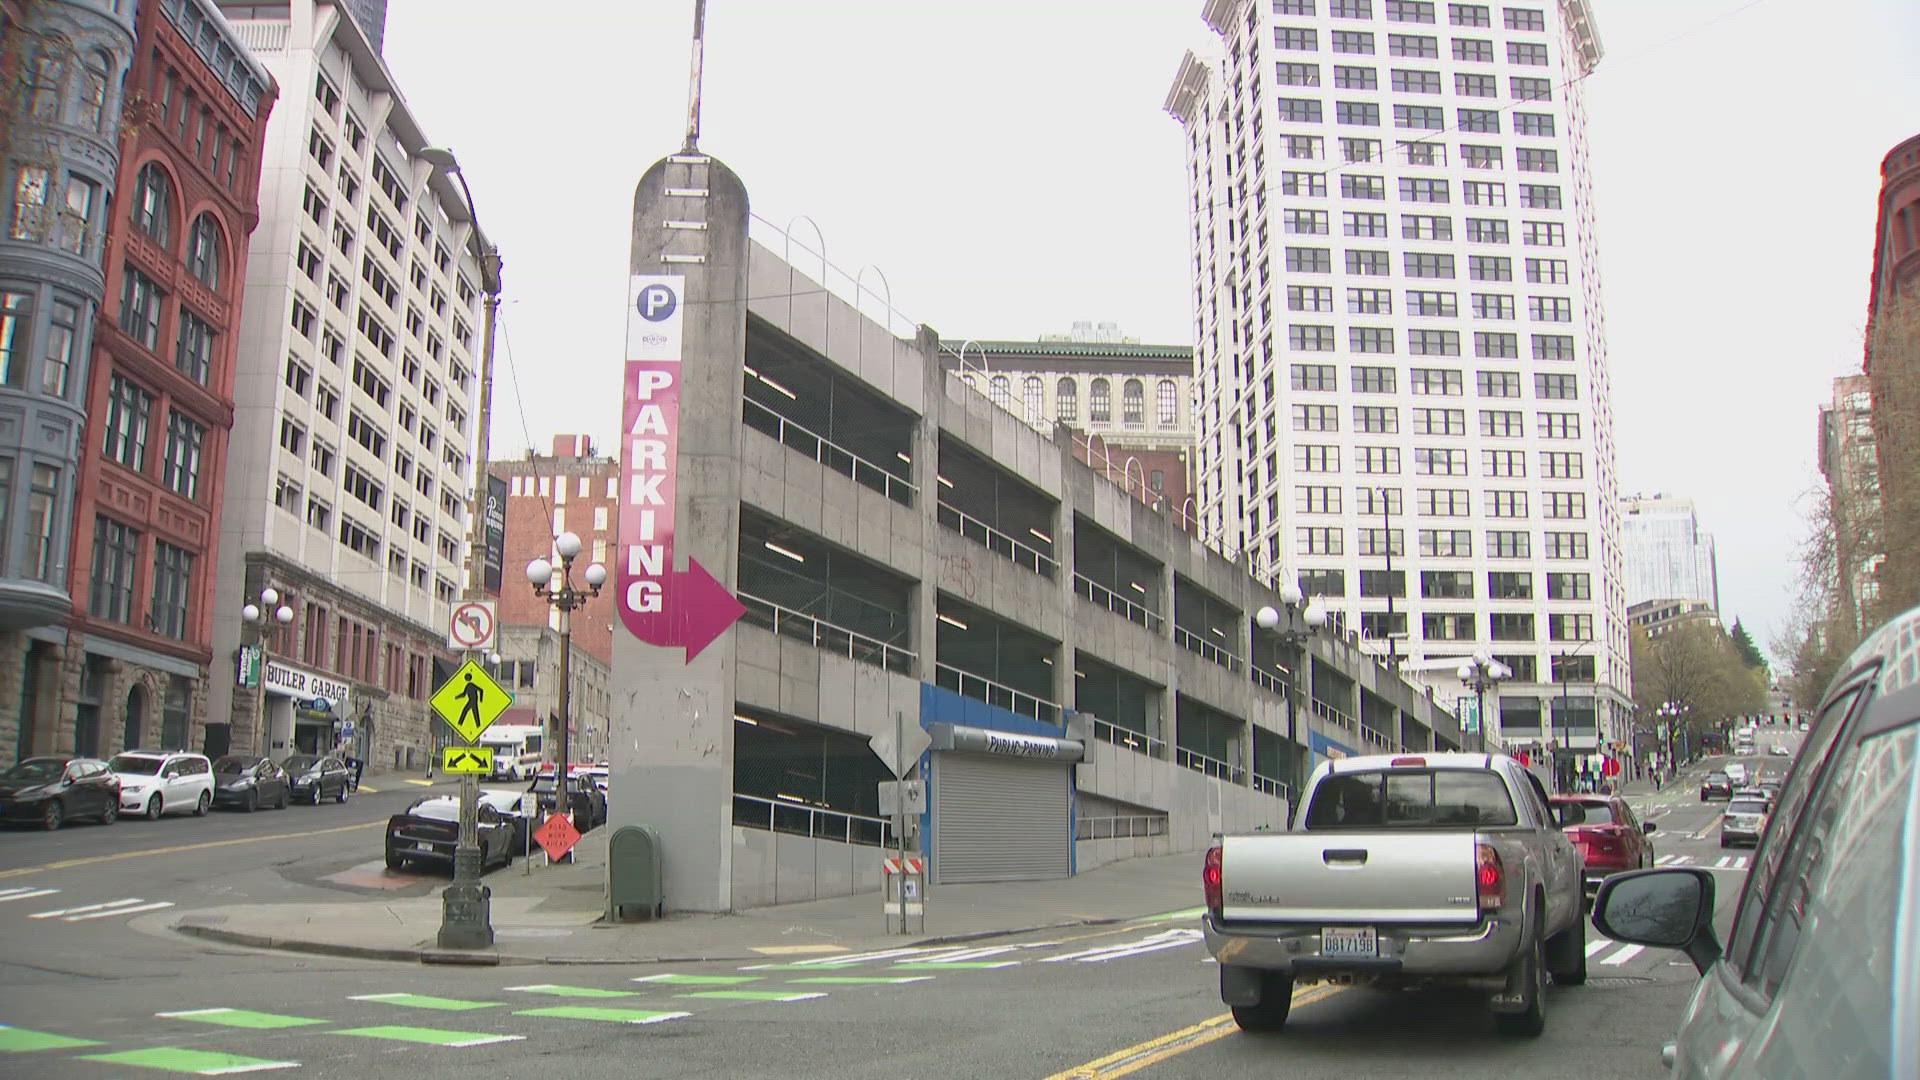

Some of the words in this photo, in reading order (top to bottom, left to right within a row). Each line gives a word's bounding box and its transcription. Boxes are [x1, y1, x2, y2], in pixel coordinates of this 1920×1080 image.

[647, 289, 669, 316] P
[626, 370, 673, 613] PARKING
[267, 665, 305, 692] BUTLER
[311, 678, 347, 702] GARAGE
[988, 735, 1021, 755] PUBLIC
[1022, 740, 1056, 759] PARKING
